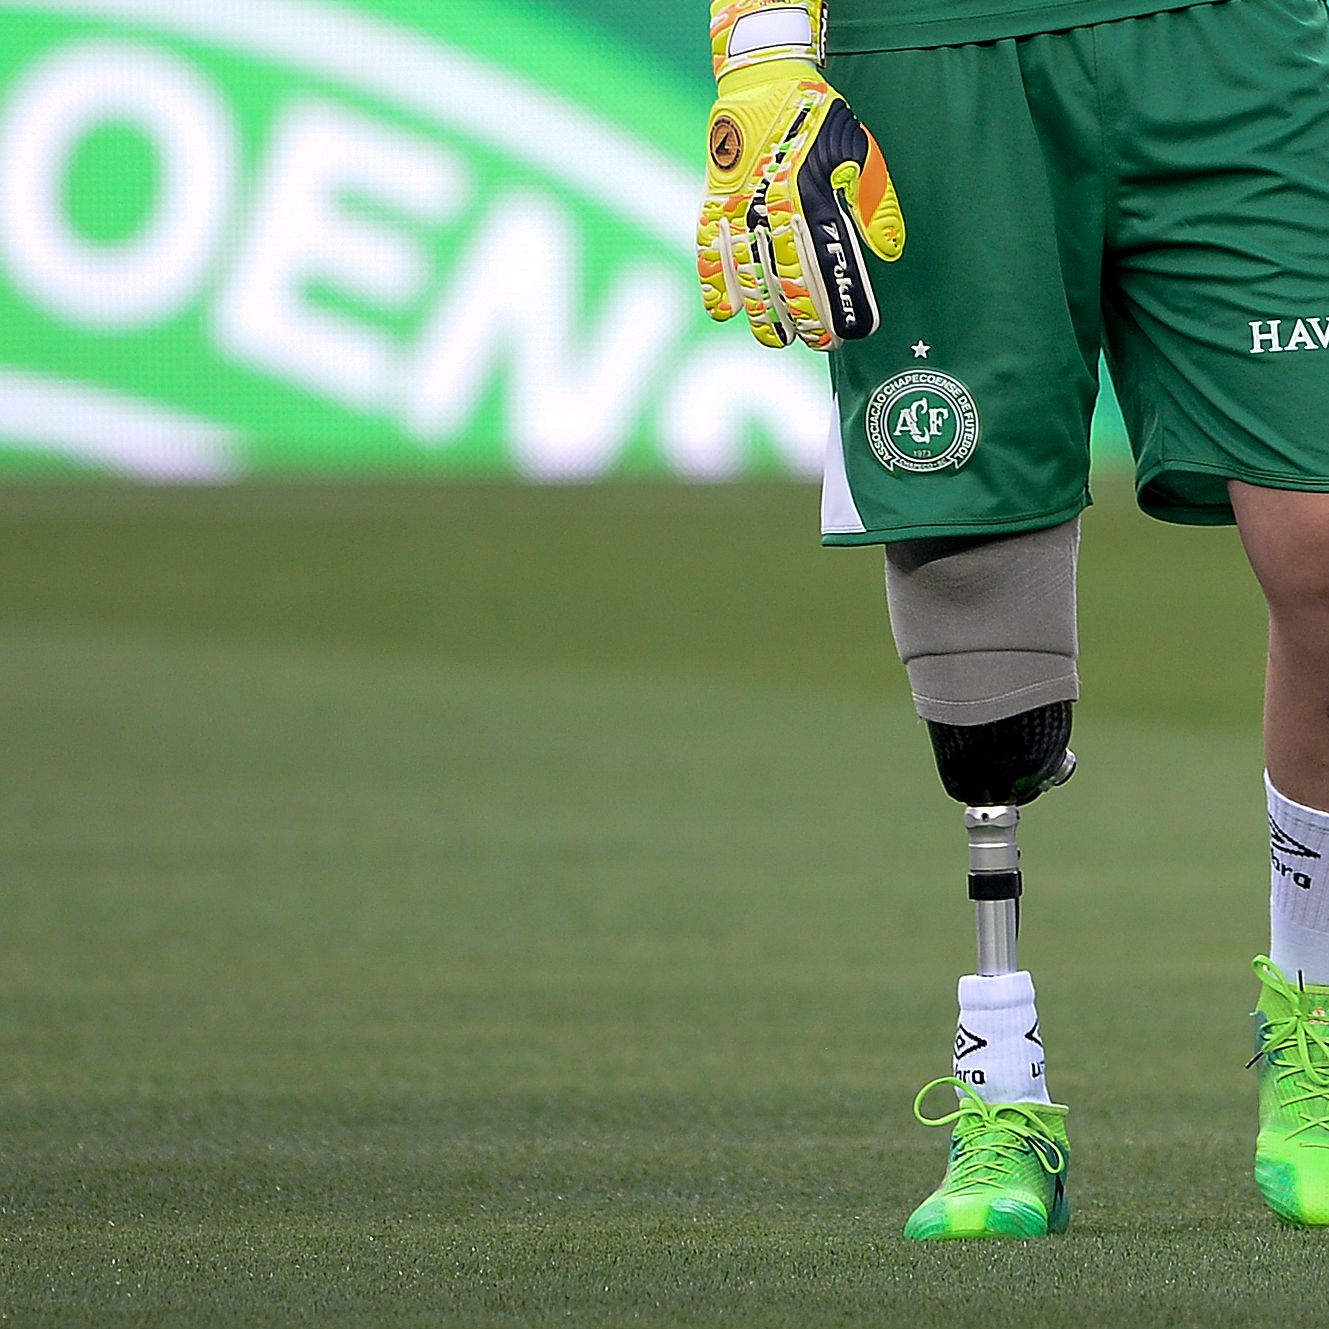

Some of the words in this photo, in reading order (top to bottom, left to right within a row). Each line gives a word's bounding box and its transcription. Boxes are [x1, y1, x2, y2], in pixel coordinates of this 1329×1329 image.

[885, 373, 962, 399] CHAPECOENSE
[957, 395, 972, 412] DE
[955, 411, 975, 460] FUTEBOL
[913, 449, 932, 457] 1973
